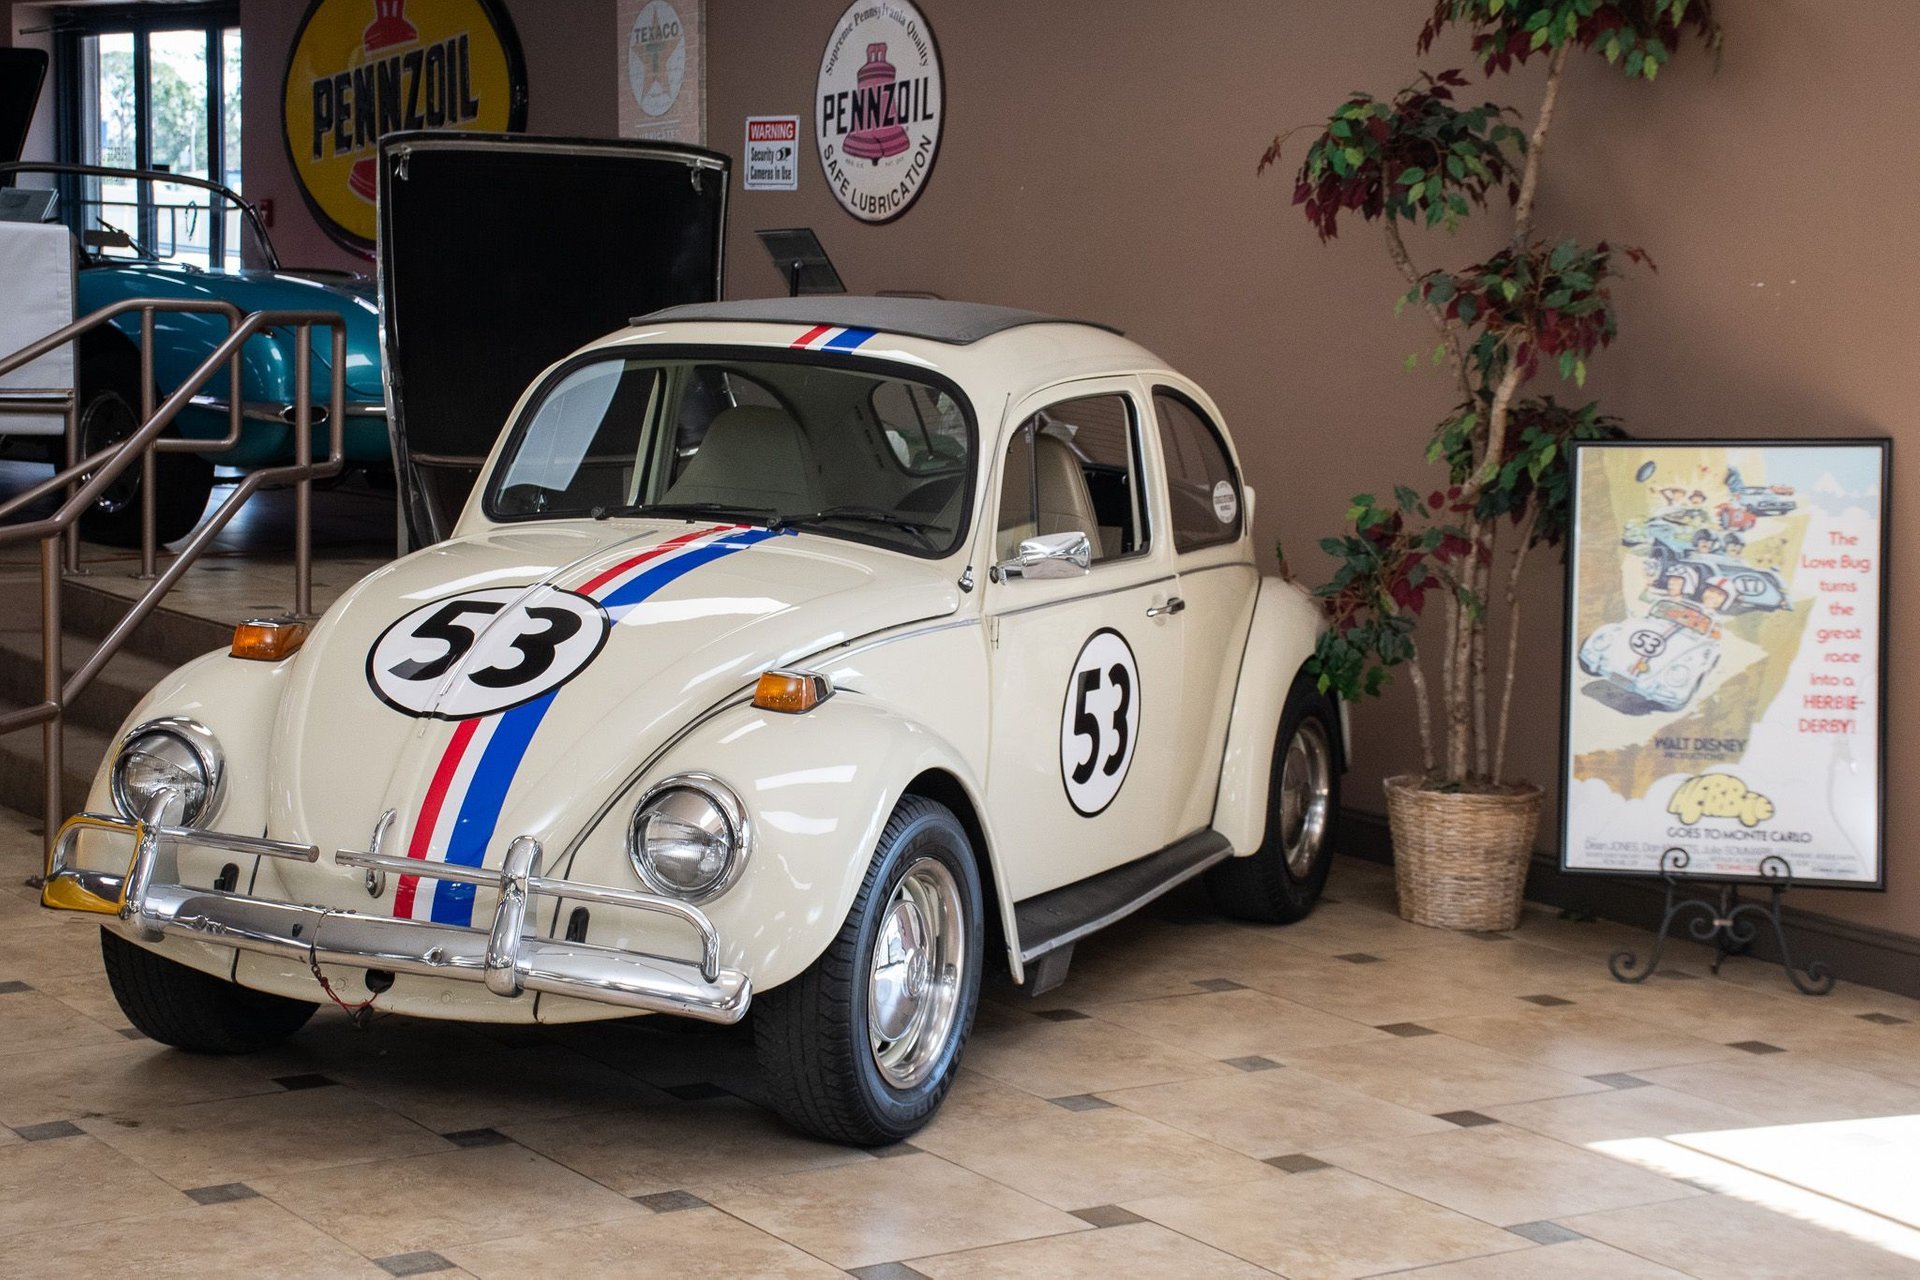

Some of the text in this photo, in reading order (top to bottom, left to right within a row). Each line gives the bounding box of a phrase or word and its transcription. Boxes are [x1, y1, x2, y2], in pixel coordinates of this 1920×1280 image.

[634, 22, 679, 43] TEXACO
[824, 2, 929, 76] Supreme Pennsylvania Quality
[312, 34, 479, 160] PENNZOIL
[822, 77, 934, 138] PENNZOIL
[750, 123, 795, 140] WARNING
[751, 147, 775, 164] Security
[751, 166, 774, 180] Cameras
[782, 166, 792, 180] Use
[824, 134, 933, 214] SAFE LUBRICATION
[1828, 531, 1859, 546] The
[1802, 554, 1872, 573] Love Bug
[1741, 578, 1760, 593] 17
[1819, 580, 1857, 592] turns
[1828, 601, 1855, 615] the
[1632, 633, 1661, 655] 53
[1817, 628, 1861, 643] great
[387, 600, 584, 689] 53
[1824, 653, 1861, 663] race
[1810, 673, 1855, 686] into a
[1072, 663, 1131, 785] 53
[1655, 737, 1747, 753] WALT DISNEY
[1666, 827, 1813, 843] GOES TO MONTE CARLO
